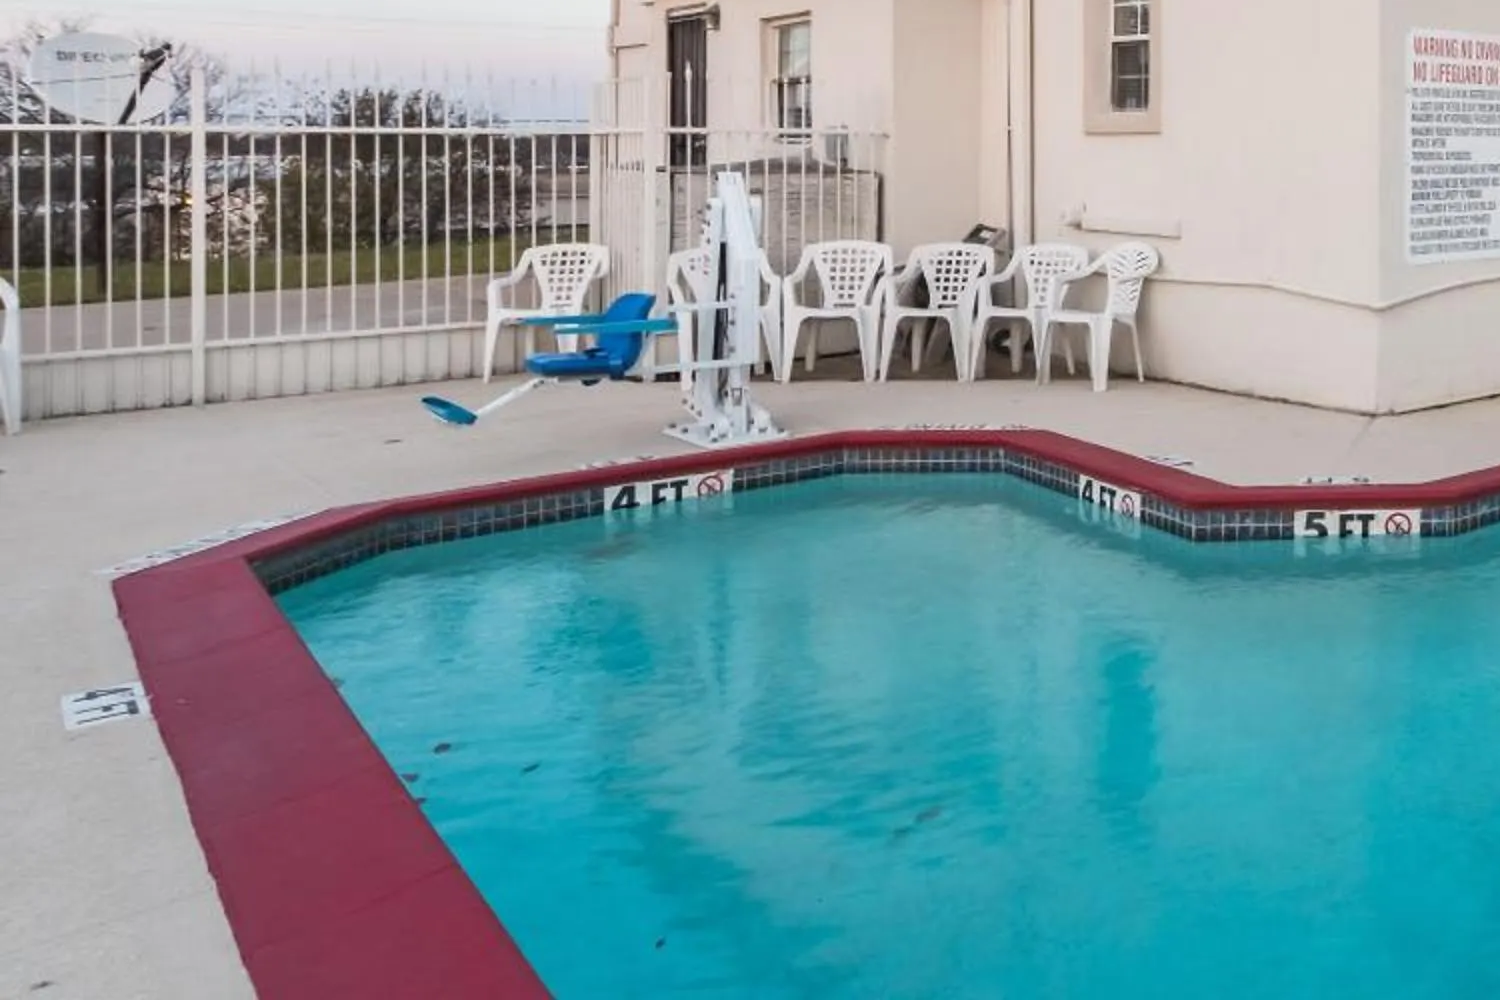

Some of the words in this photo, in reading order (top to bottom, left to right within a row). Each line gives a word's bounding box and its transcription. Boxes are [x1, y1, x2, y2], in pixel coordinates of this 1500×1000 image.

[1413, 35, 1458, 58] WARNING
[1461, 39, 1473, 59] NO
[1413, 61, 1427, 82] NO
[1431, 62, 1482, 84] LIFEGUARD
[1485, 66, 1499, 86] ON
[611, 486, 640, 510] 4
[651, 480, 689, 505] FT
[1082, 480, 1094, 503] 4
[1100, 486, 1116, 511] FT
[1304, 512, 1328, 538] 5
[1339, 514, 1375, 537] FT
[74, 700, 139, 725] FT
